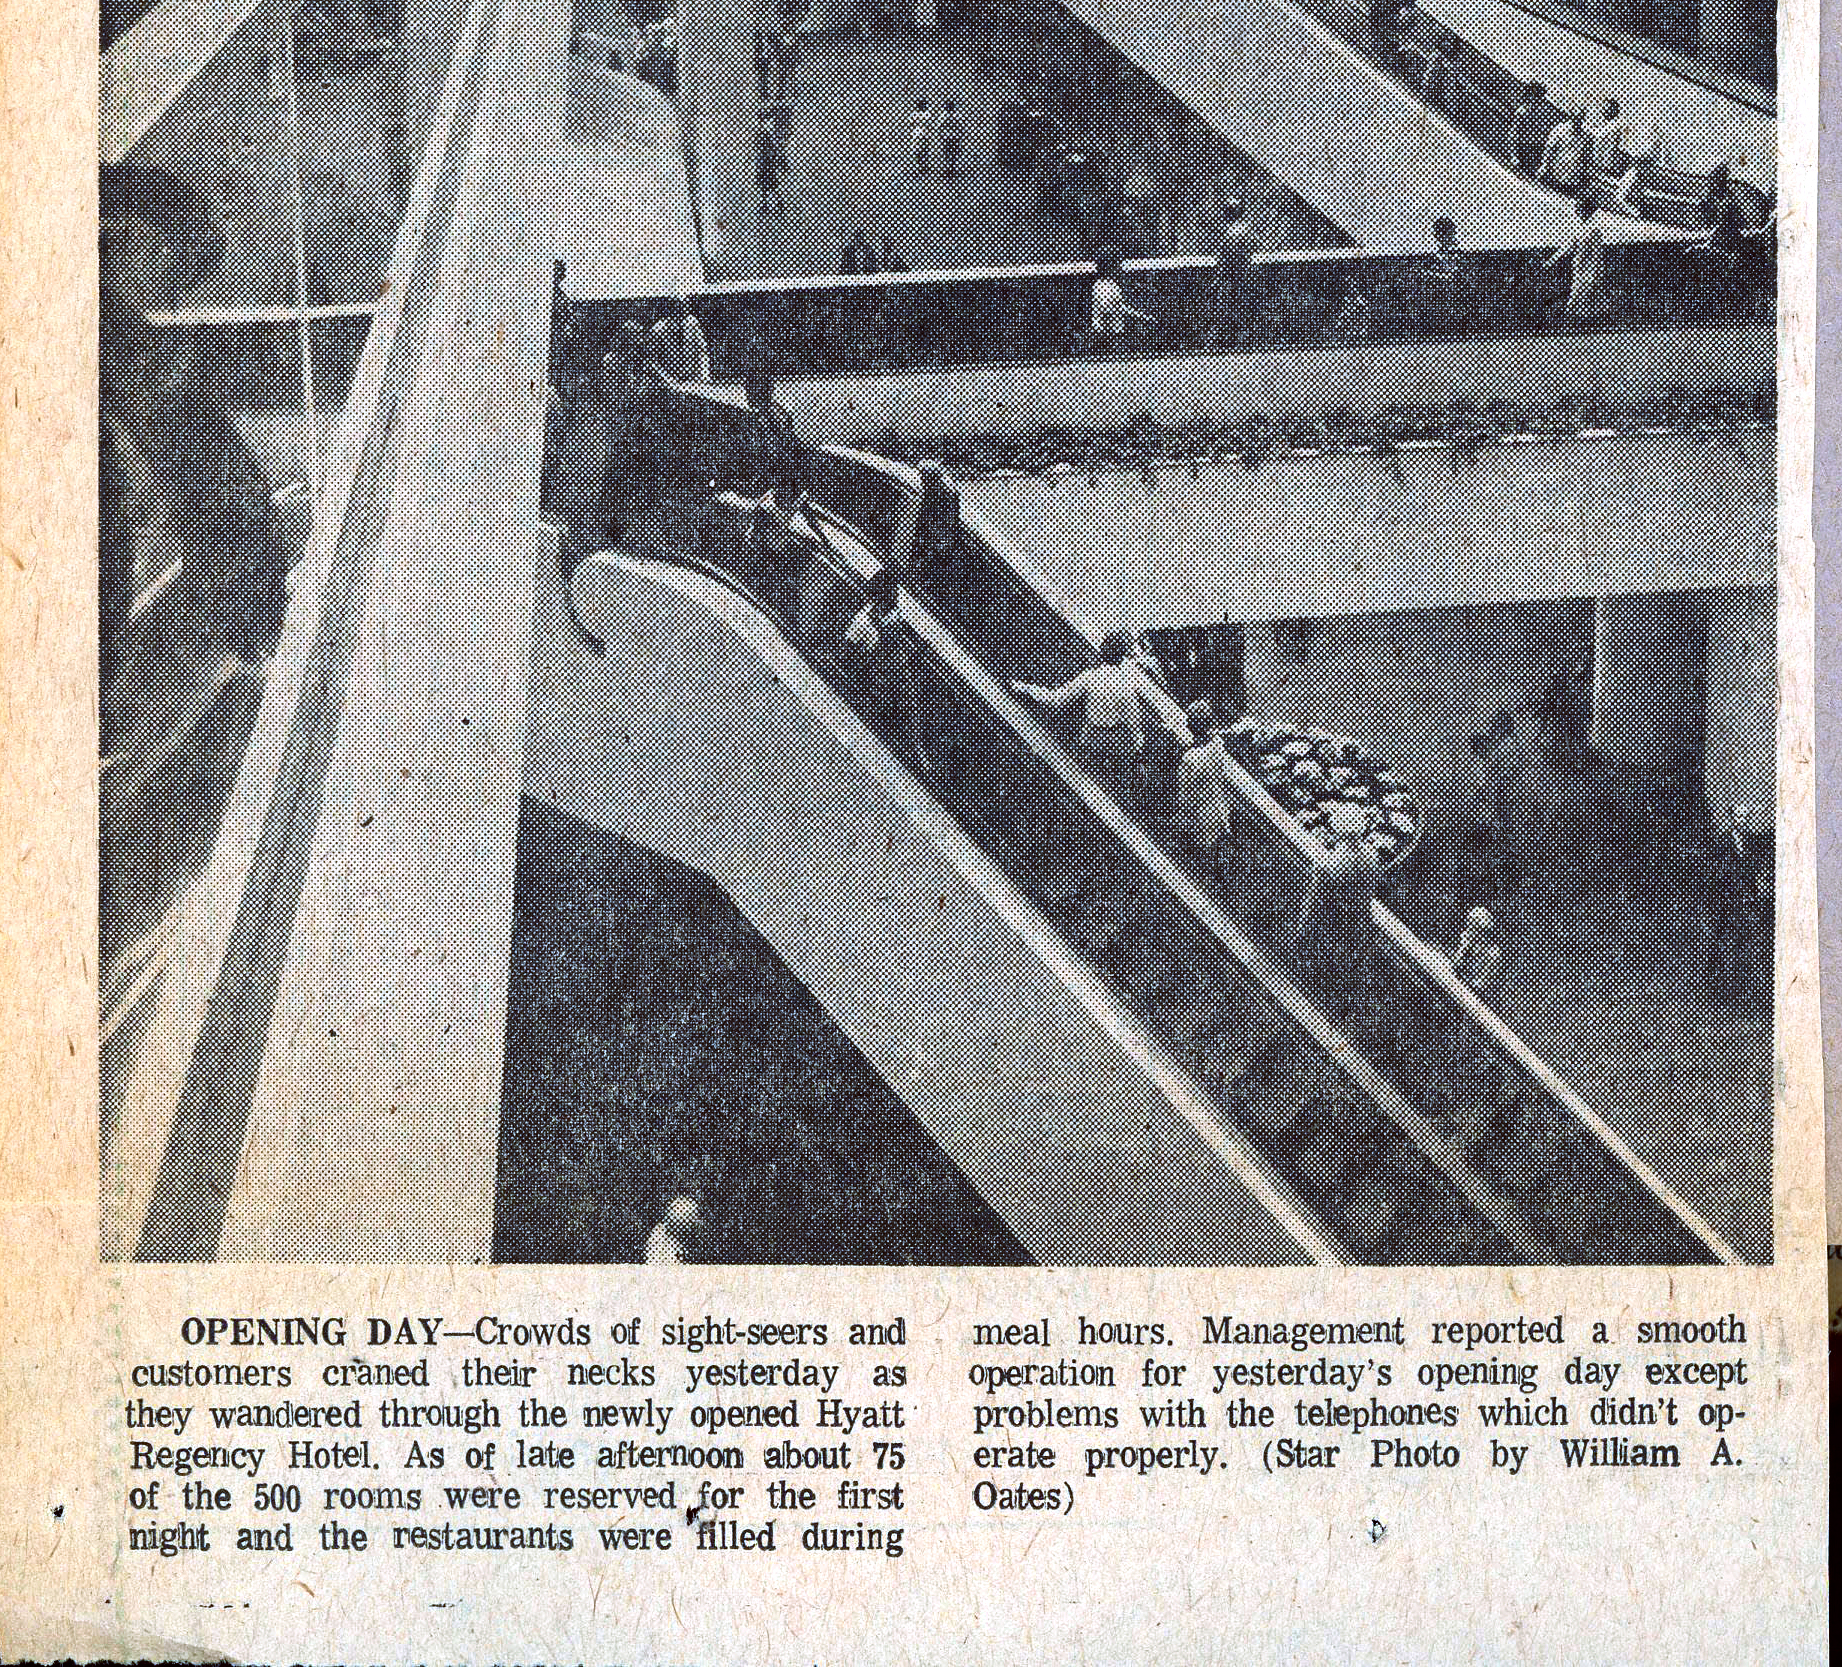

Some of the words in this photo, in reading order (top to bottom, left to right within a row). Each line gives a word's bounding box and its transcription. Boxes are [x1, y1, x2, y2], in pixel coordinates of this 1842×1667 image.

[182, 1317, 346, 1346] OPENING
[611, 1317, 640, 1345] of
[663, 1316, 827, 1354] sight-seers
[849, 1317, 905, 1345] and
[974, 1316, 1050, 1346] meal
[1079, 1316, 1174, 1346] hours.
[1203, 1317, 1404, 1351] Management
[1432, 1315, 1564, 1350] reported
[1593, 1323, 1609, 1343] a
[1638, 1314, 1746, 1343] smooth
[132, 1361, 291, 1387] customers
[323, 1360, 429, 1387] craned
[462, 1358, 536, 1387] their
[568, 1358, 655, 1386] necks
[686, 1359, 839, 1393] yesterday
[873, 1366, 906, 1387] as
[969, 1359, 1116, 1394] operation
[1142, 1359, 1186, 1387] for
[1213, 1358, 1391, 1394] yesterday's
[1418, 1357, 1538, 1393] opening
[1565, 1357, 1621, 1391] day
[1646, 1358, 1747, 1390] except
[125, 1399, 192, 1435] they
[209, 1400, 362, 1428] wandered
[379, 1398, 500, 1434] through
[520, 1398, 567, 1427] the
[583, 1398, 673, 1435] newly
[691, 1400, 799, 1434] opened
[816, 1399, 905, 1434] Hyatt
[974, 1399, 1118, 1434] problems
[1140, 1399, 1206, 1427] with
[1227, 1398, 1273, 1428] the
[1295, 1398, 1458, 1434] telephones
[1478, 1397, 1568, 1427] which
[1591, 1397, 1678, 1425] didn't
[1699, 1404, 1745, 1432] op-
[130, 1441, 265, 1477] Regency
[289, 1441, 379, 1469] Hotel.
[404, 1441, 444, 1468] As
[466, 1443, 495, 1470] of
[516, 1440, 574, 1468] late
[598, 1441, 743, 1469] afternoon
[764, 1440, 851, 1469] about
[873, 1442, 905, 1469] 75
[974, 1442, 1055, 1468] erate
[1086, 1440, 1226, 1477] properly.
[1264, 1439, 1340, 1473] (Star
[1371, 1438, 1459, 1467] Photo
[1491, 1440, 1528, 1475] by
[1560, 1437, 1680, 1467] William
[1711, 1438, 1742, 1467] A.
[130, 1481, 159, 1509] of
[182, 1481, 231, 1510] the
[255, 1483, 301, 1512] 500
[324, 1488, 421, 1510] rooms
[444, 1487, 520, 1509] were
[544, 1482, 676, 1509] reserved
[697, 1481, 744, 1510] for
[767, 1480, 815, 1509] the
[838, 1481, 904, 1509] first
[974, 1481, 1073, 1515] Oates)
[130, 1522, 210, 1557] night
[237, 1523, 293, 1551] and
[319, 1521, 367, 1551] the
[394, 1522, 573, 1551] restaurants
[599, 1529, 671, 1550] were
[697, 1522, 776, 1551] filled
[802, 1522, 904, 1557] during
